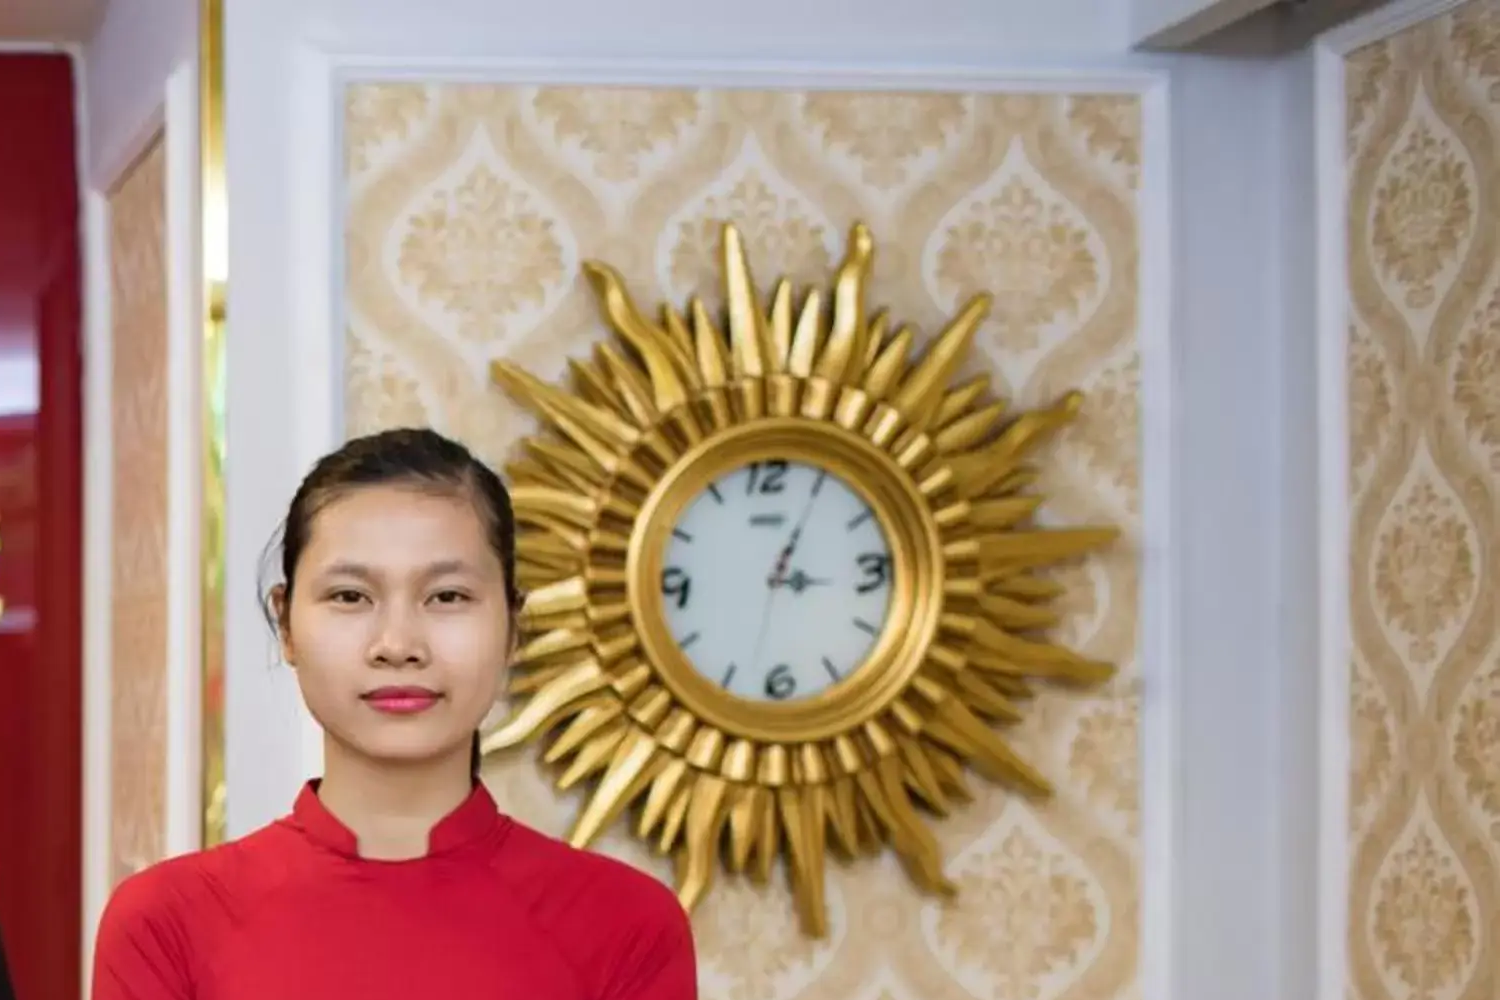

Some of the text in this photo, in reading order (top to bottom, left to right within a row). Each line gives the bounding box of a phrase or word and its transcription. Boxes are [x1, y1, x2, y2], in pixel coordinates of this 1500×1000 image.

[746, 459, 788, 496] 12
[662, 567, 690, 608] 9
[856, 553, 890, 594] 3
[764, 664, 796, 700] 6
